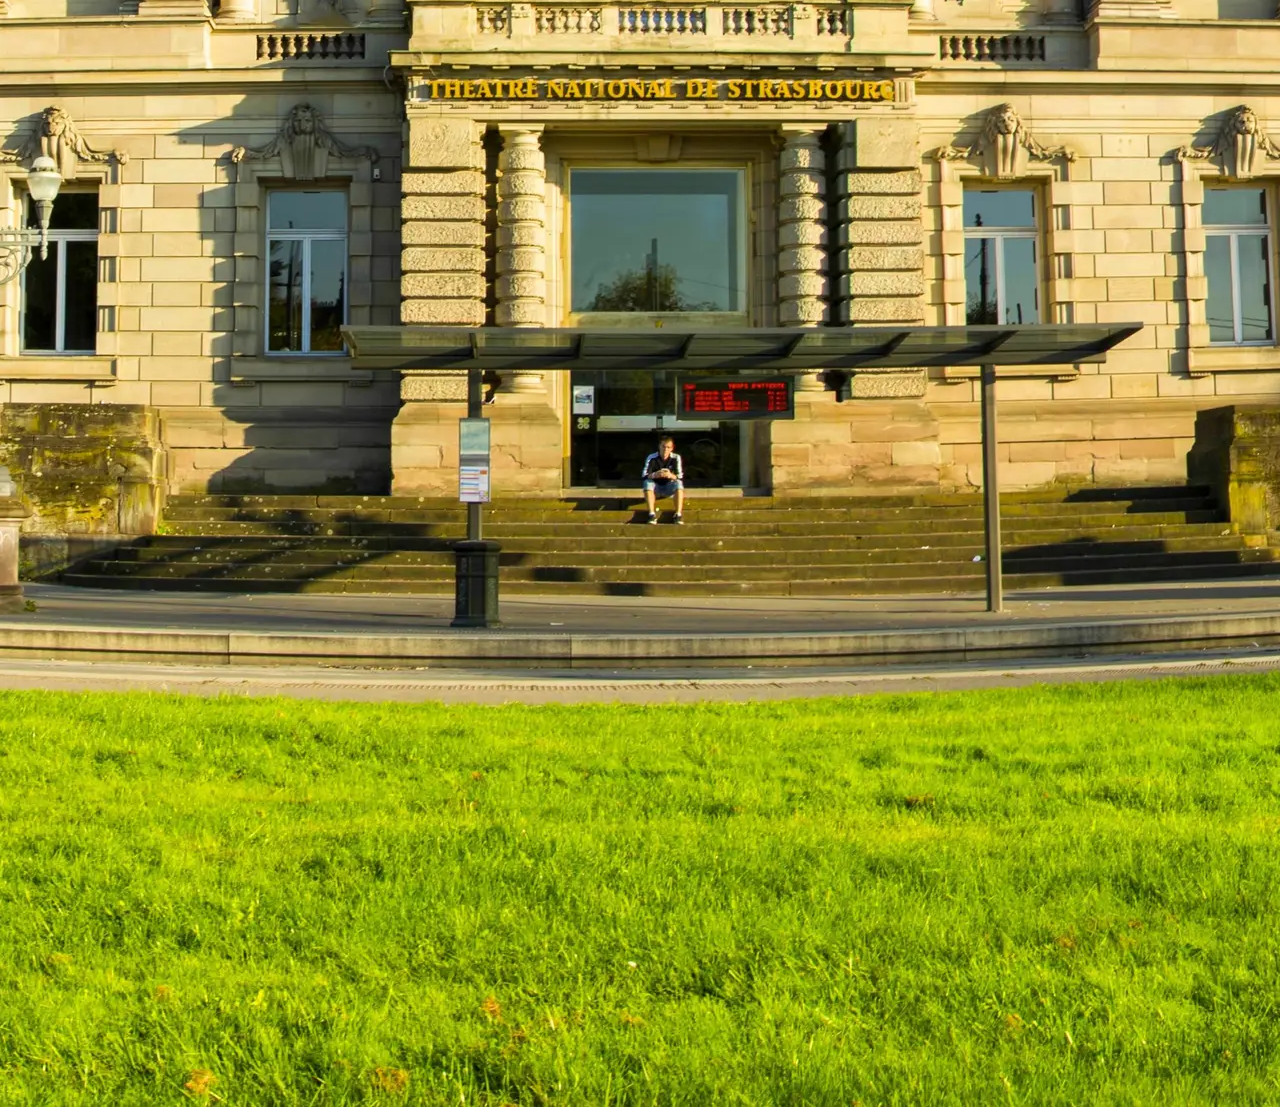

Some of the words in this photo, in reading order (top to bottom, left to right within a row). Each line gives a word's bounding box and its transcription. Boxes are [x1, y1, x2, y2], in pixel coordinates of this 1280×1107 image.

[546, 79, 677, 99] NATIONAL
[686, 79, 719, 99] DE
[727, 79, 895, 101] STRASBOURG
